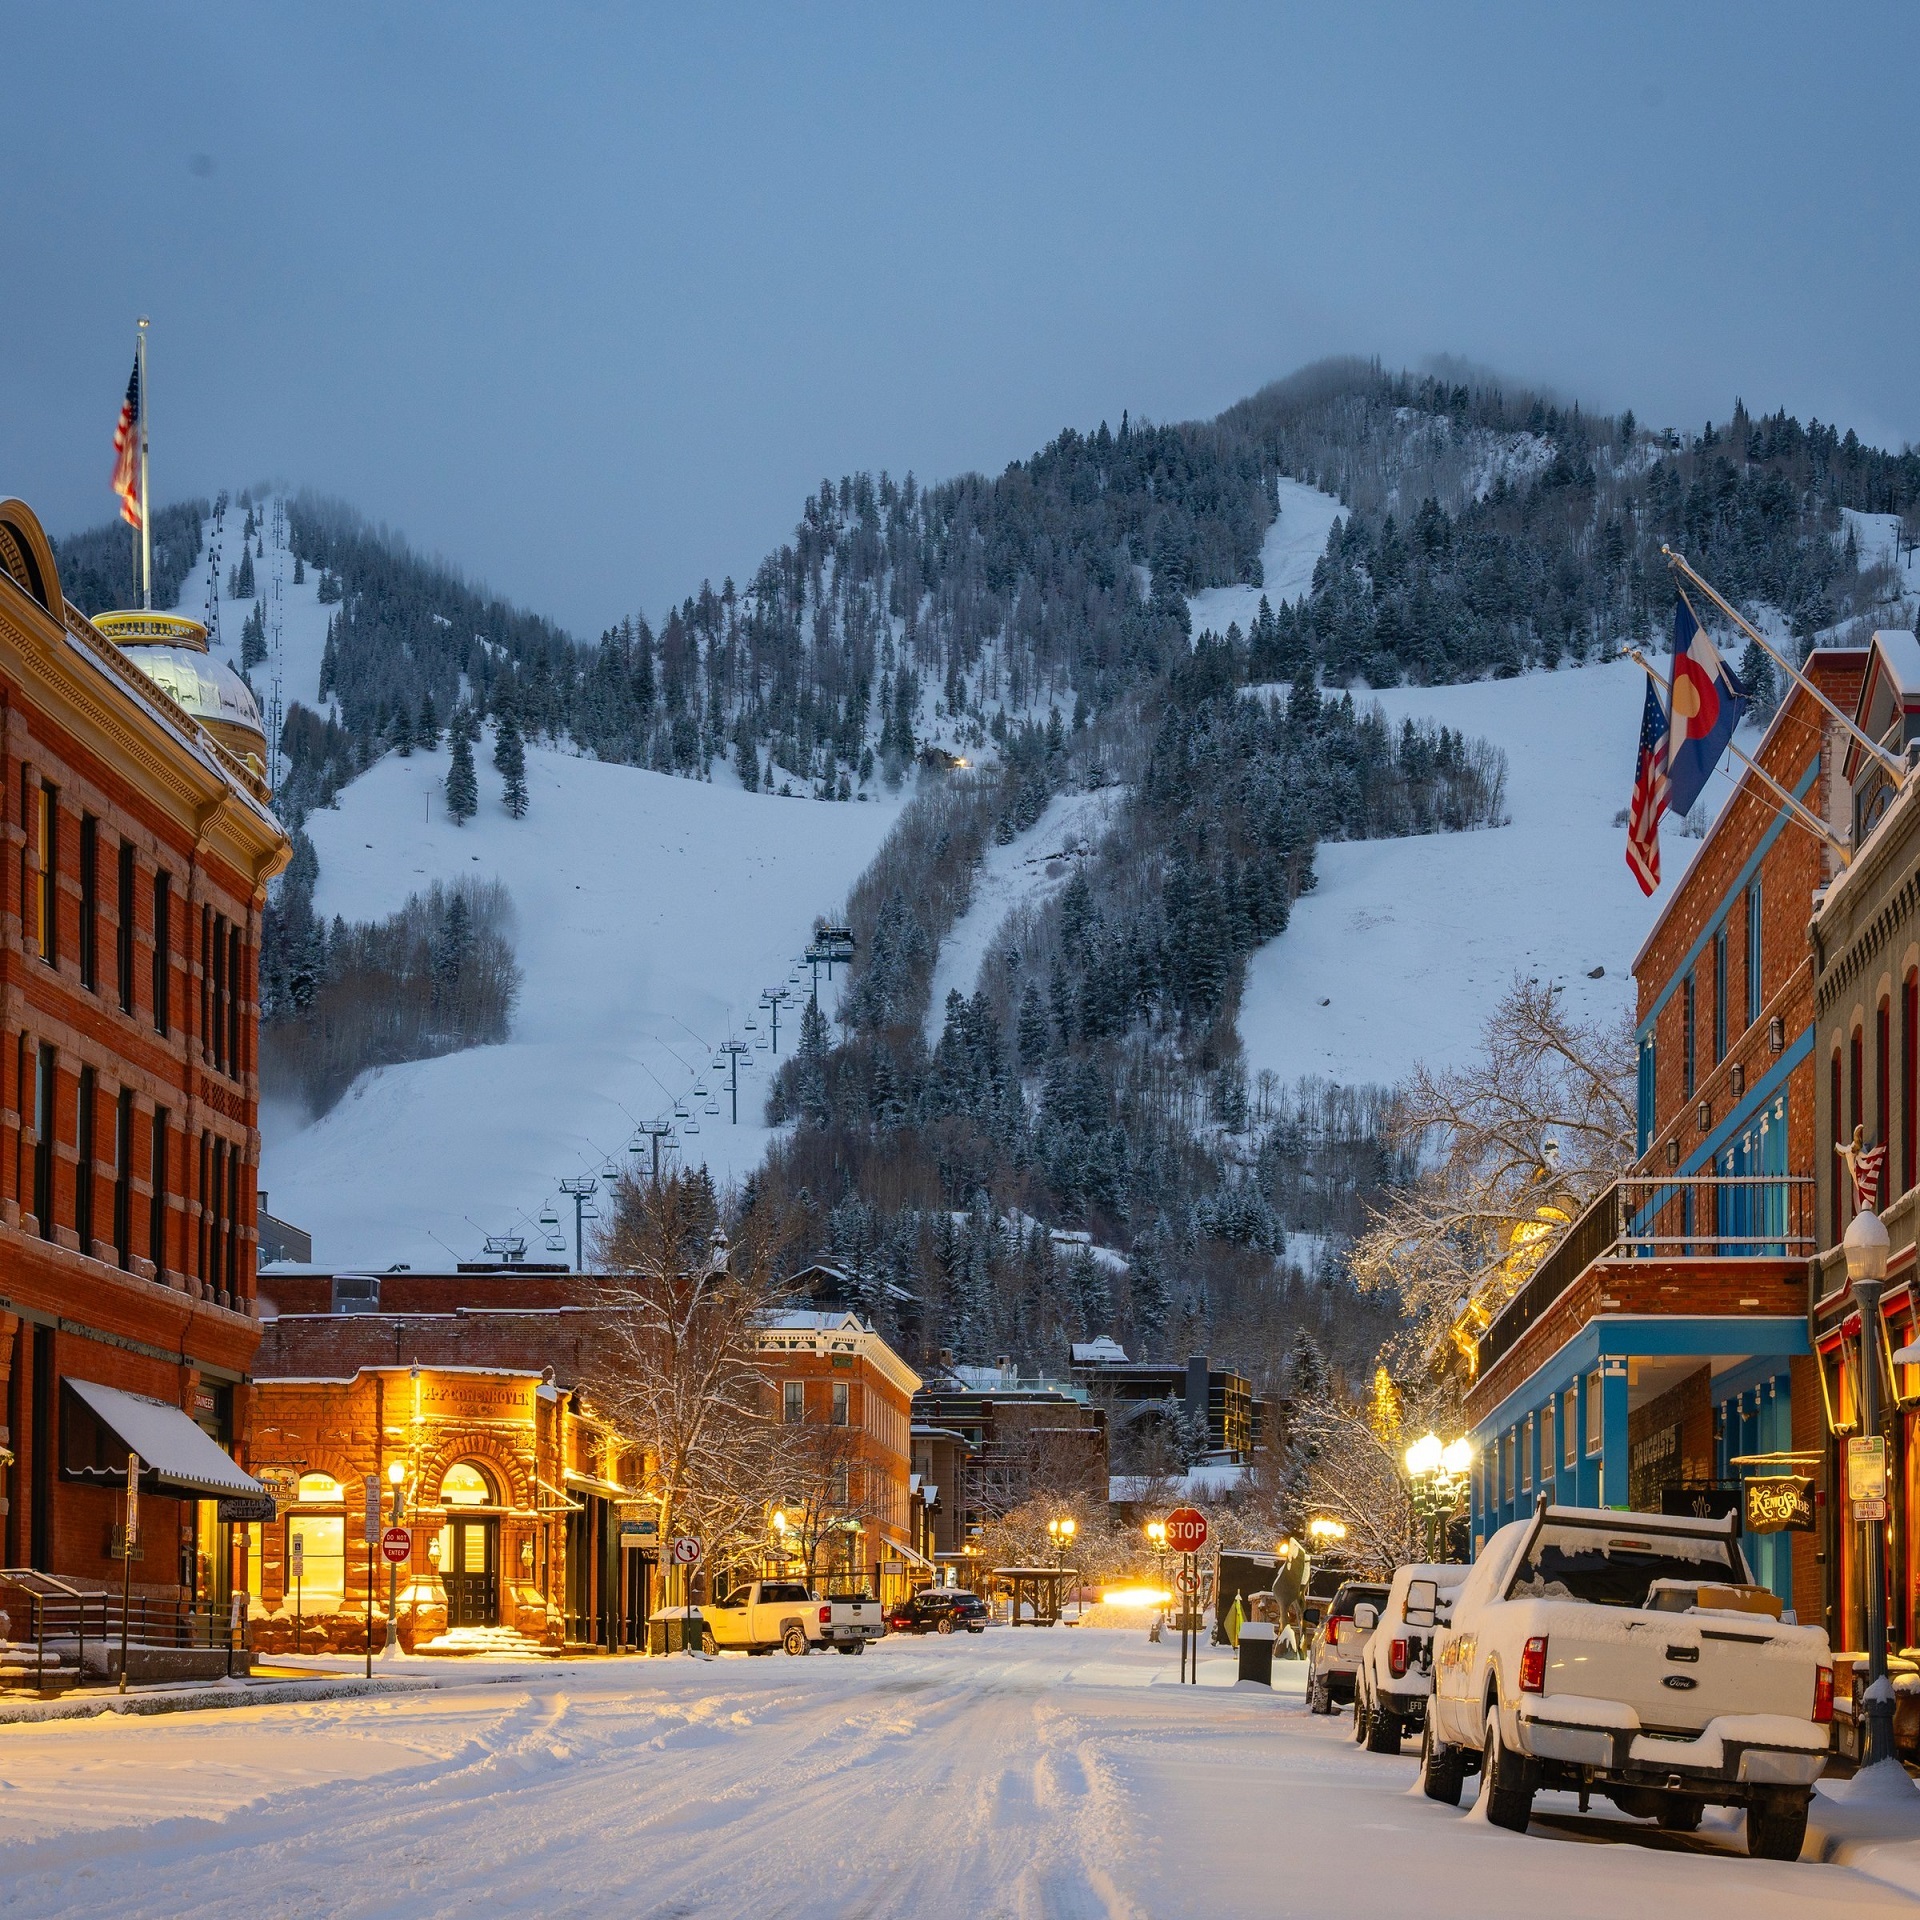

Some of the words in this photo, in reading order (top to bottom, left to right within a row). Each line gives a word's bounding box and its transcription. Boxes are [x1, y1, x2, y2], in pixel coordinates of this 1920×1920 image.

[236, 1507, 256, 1516] CITY
[1167, 1522, 1205, 1539] STOP
[1670, 1677, 1690, 1688] Ford
